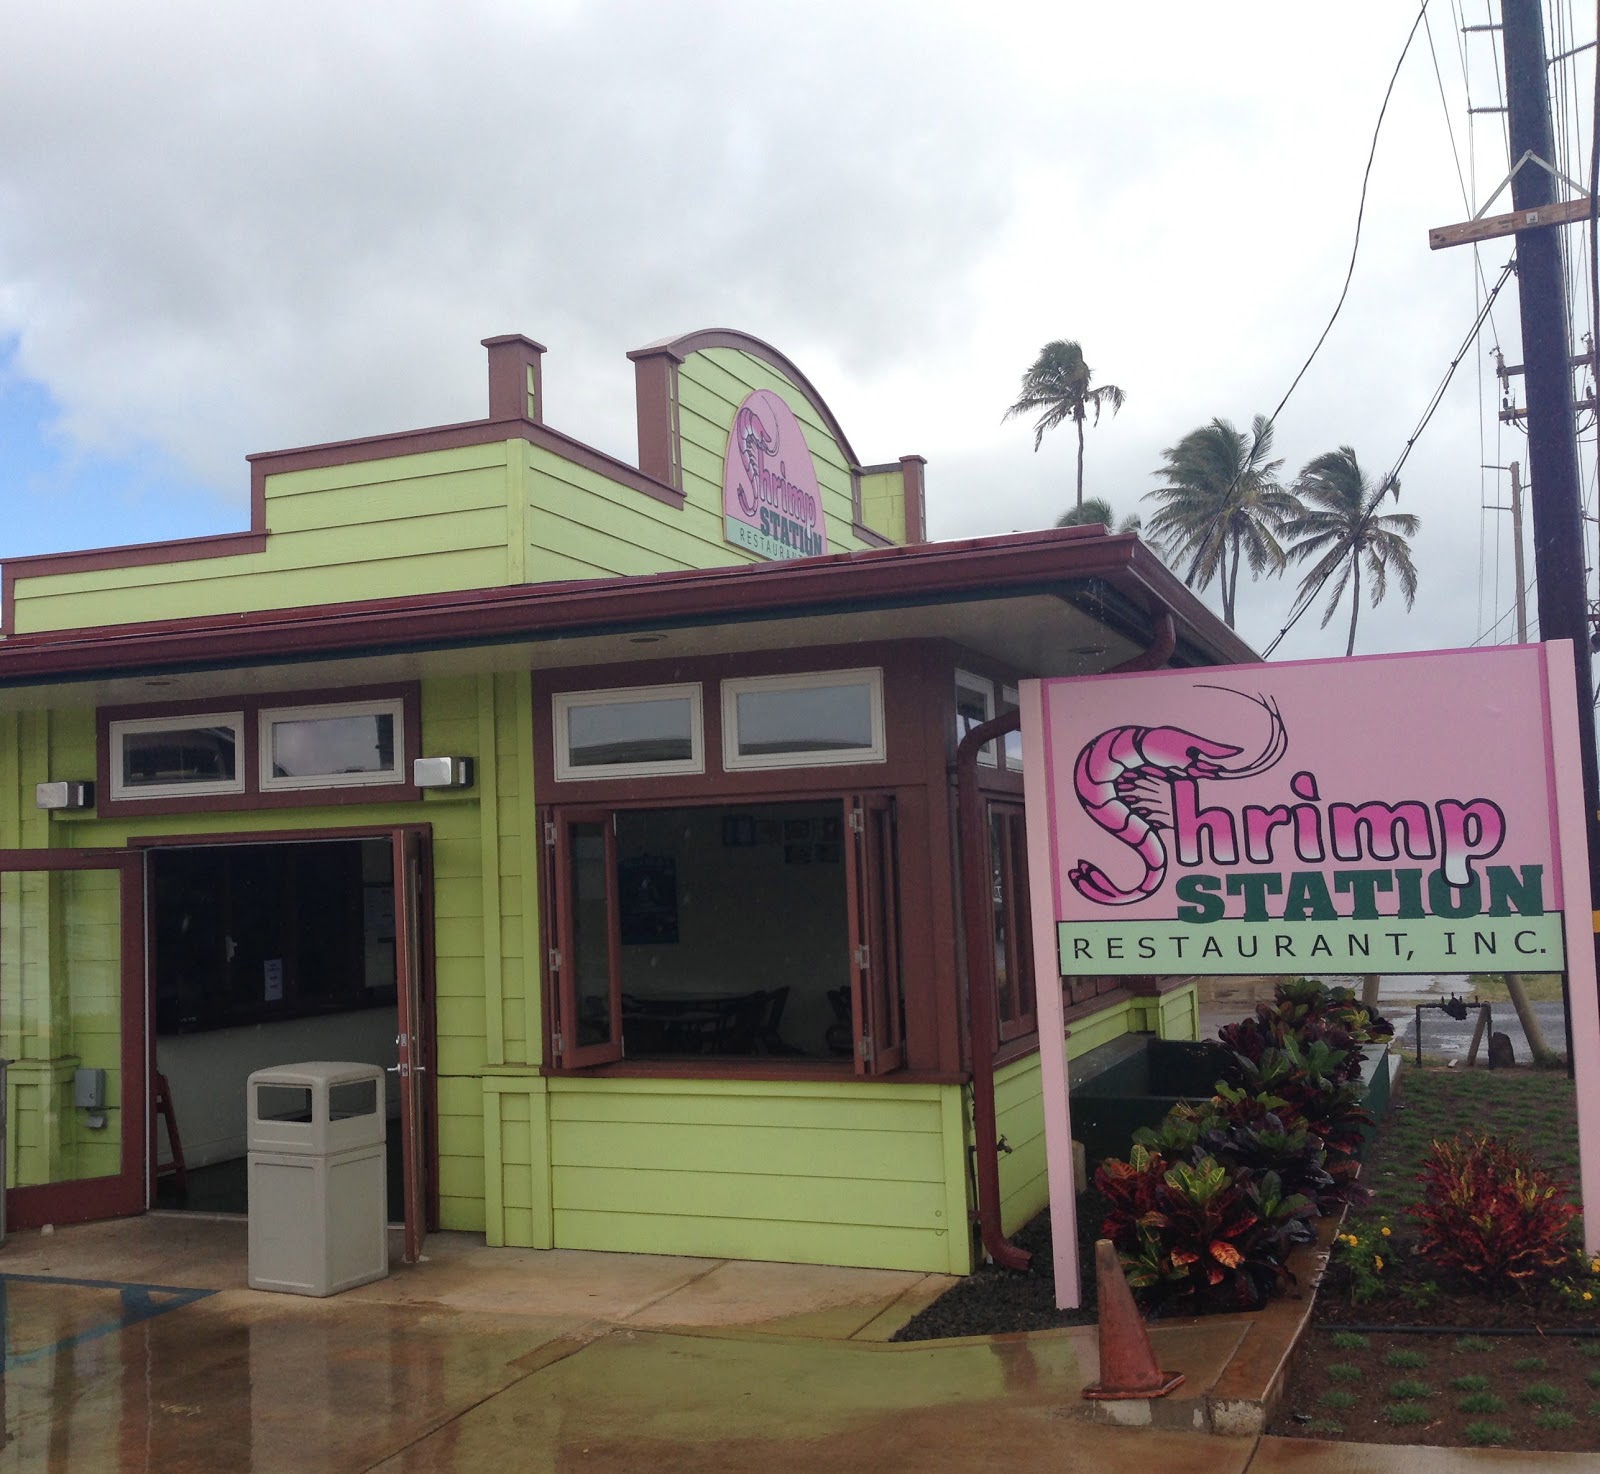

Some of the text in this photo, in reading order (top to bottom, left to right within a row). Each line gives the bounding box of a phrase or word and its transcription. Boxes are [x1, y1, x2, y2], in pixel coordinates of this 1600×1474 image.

[737, 406, 817, 539] Shrimp
[740, 527, 802, 560] RESTAURAN
[760, 506, 822, 556] STATION
[1067, 725, 1506, 906] Shrimp
[1175, 864, 1544, 924] STATION
[1074, 930, 1548, 962] RESTAURANT, INC.
